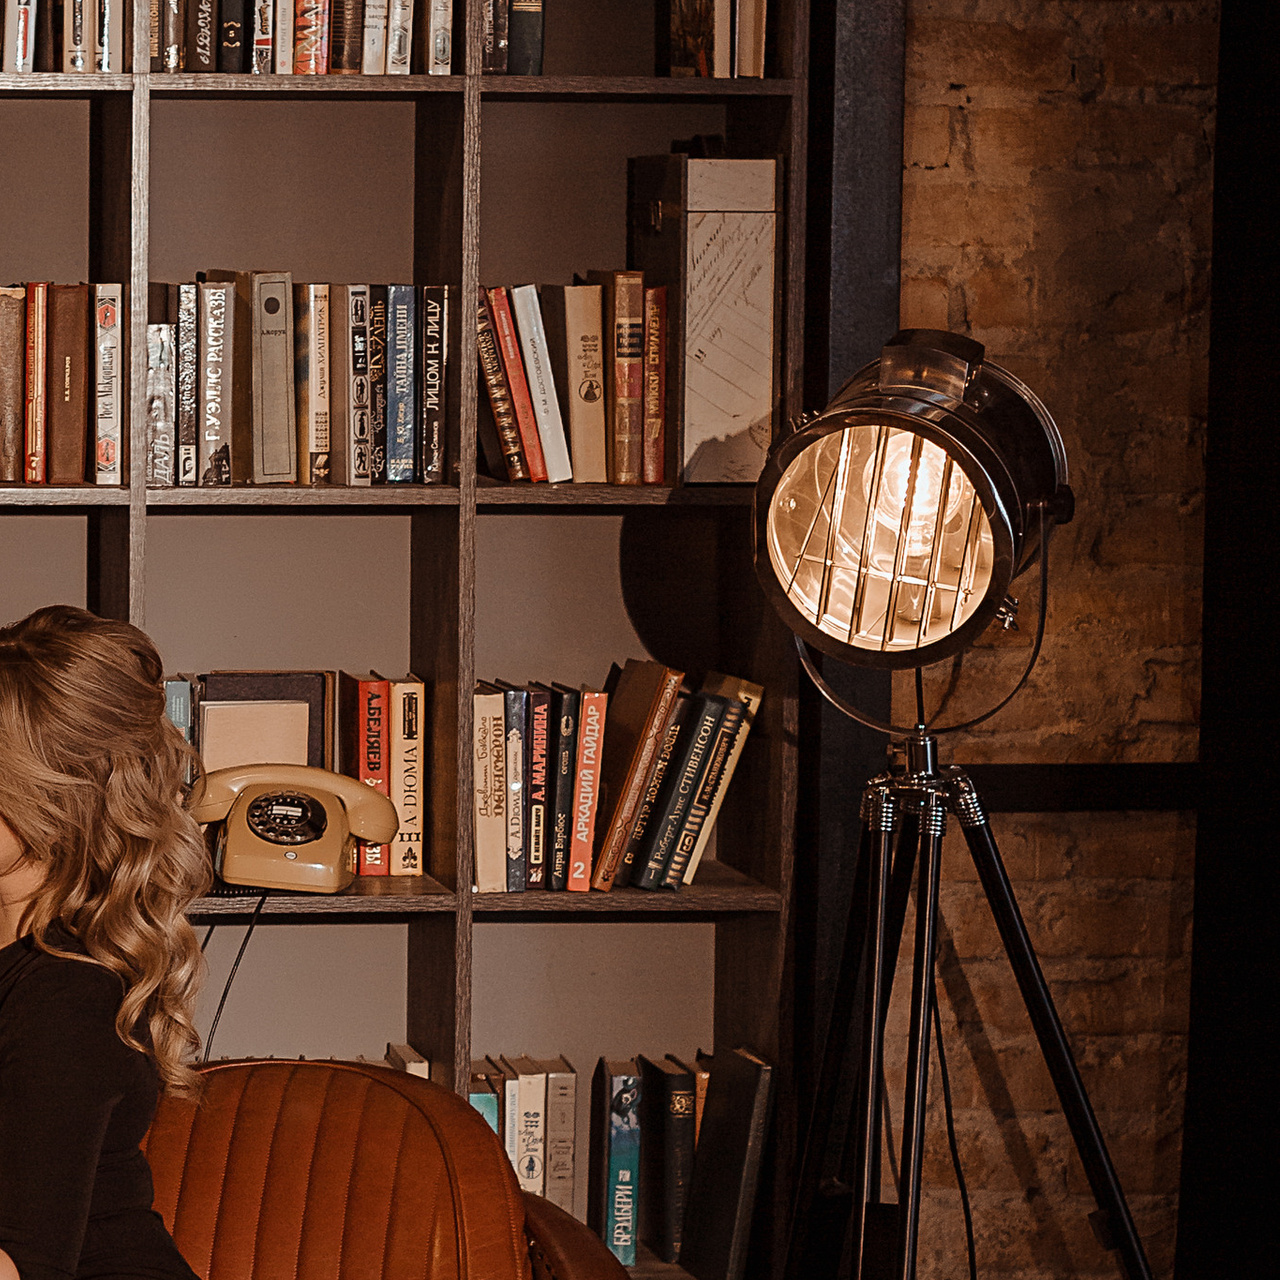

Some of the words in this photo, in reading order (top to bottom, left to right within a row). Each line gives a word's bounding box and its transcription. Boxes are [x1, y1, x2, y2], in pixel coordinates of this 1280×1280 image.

[206, 288, 225, 363] РАССКАЗЫ
[427, 300, 440, 338] ЛИЦУ
[97, 402, 113, 419] Росс
[426, 360, 441, 410] ЛИЦОМ
[155, 433, 171, 483] ДАЛЬ
[366, 691, 383, 771] А.БЕЛЯЕВ
[533, 704, 547, 785] МАРИНИНА
[583, 706, 599, 764] ГАЙДАР
[533, 788, 545, 801] А.
[577, 769, 593, 842] АРКАДИЙ
[654, 825, 675, 860] Роберт
[668, 796, 685, 821] Луис
[679, 716, 715, 794] СТИВЕНСОН
[614, 1185, 633, 1245] БРЭДБЕРИ
